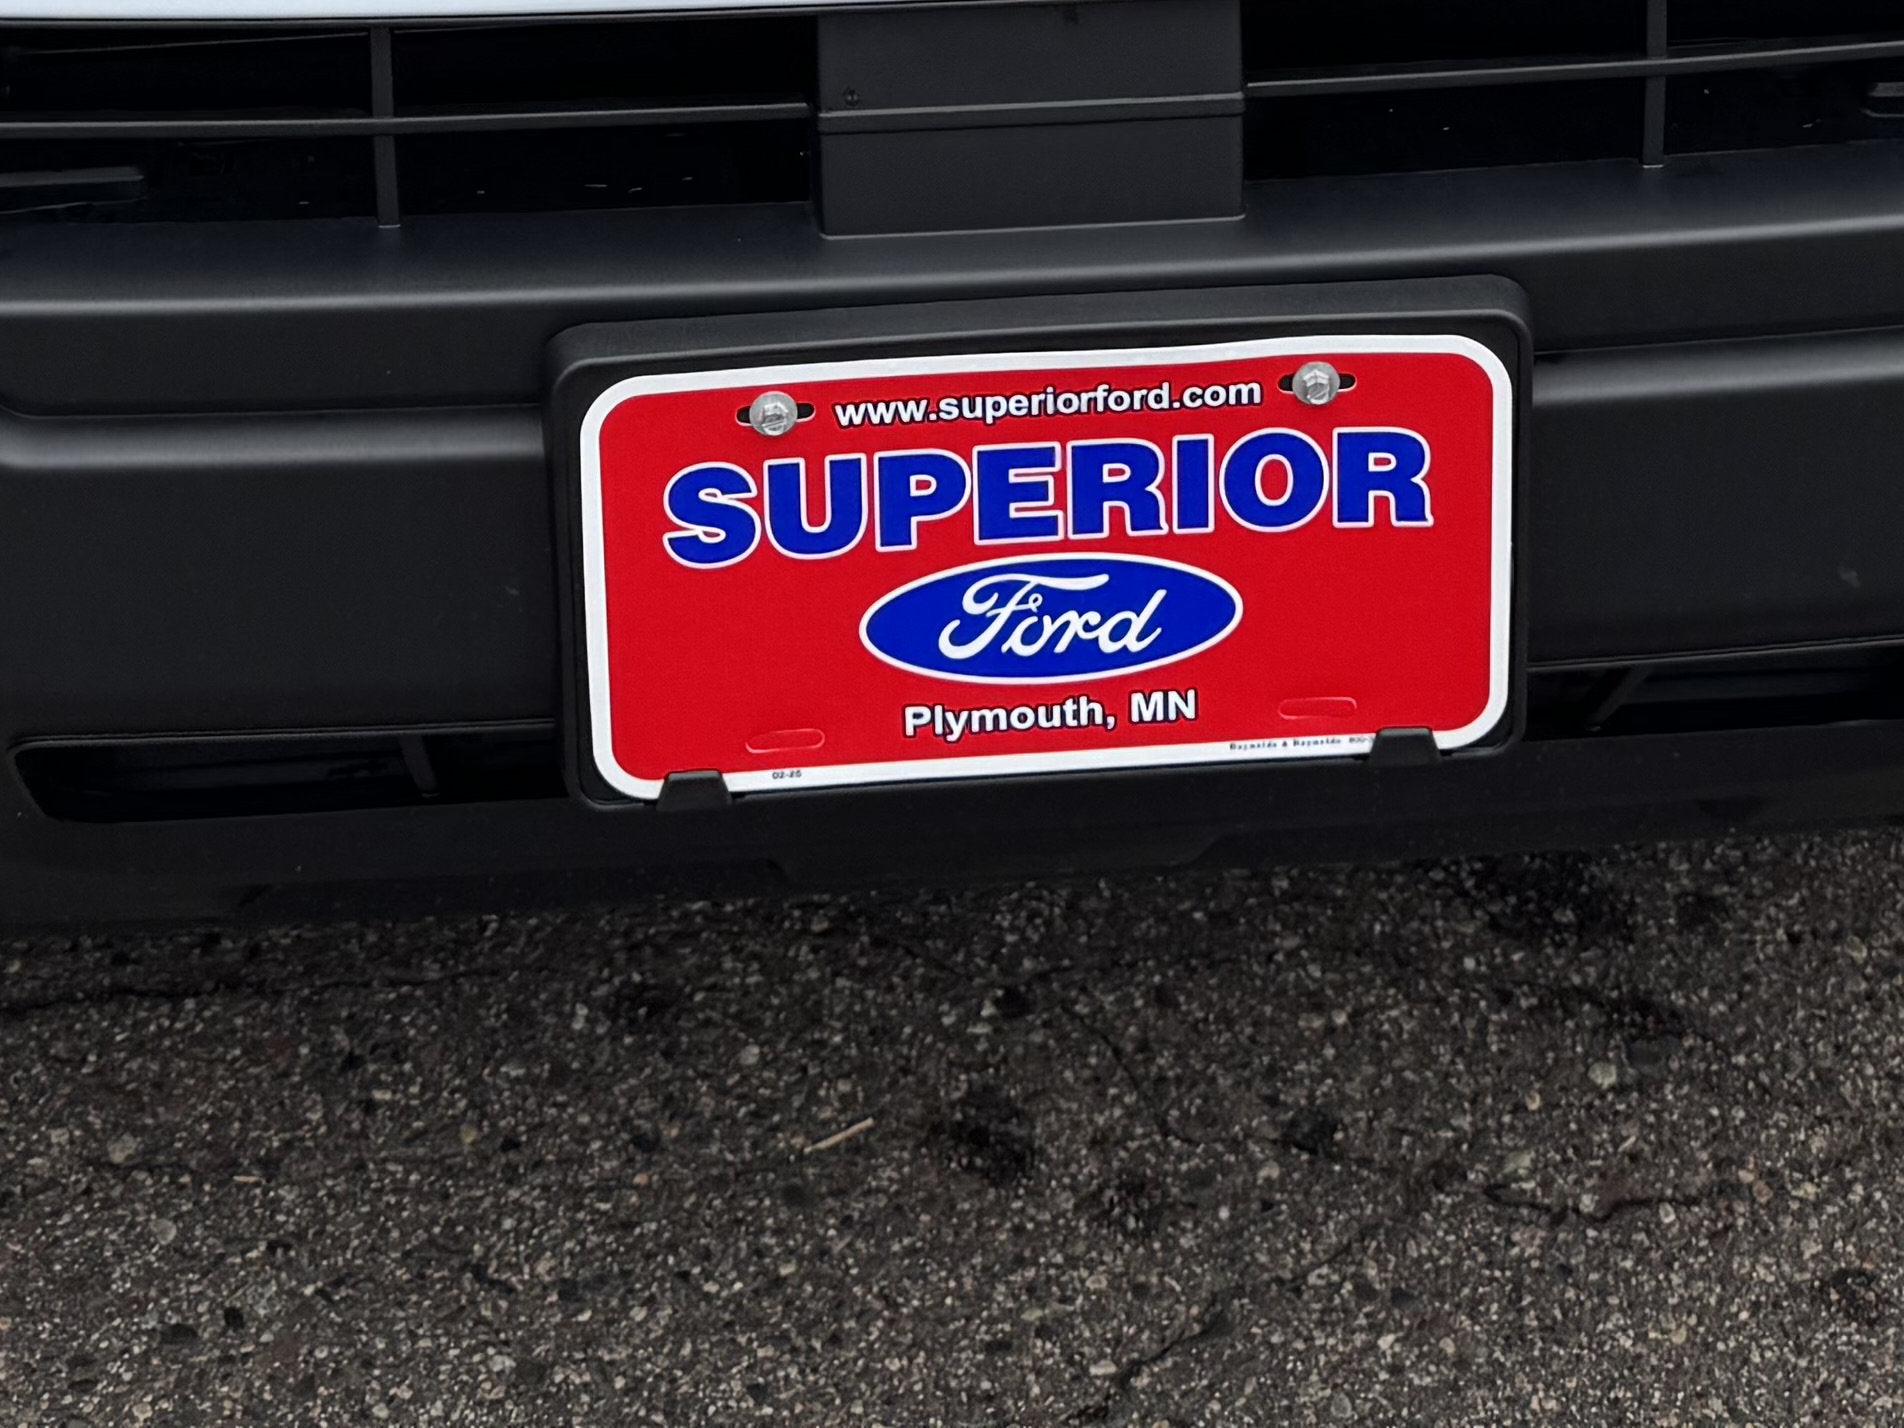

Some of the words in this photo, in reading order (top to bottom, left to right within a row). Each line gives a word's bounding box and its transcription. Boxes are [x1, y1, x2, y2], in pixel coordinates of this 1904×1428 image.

[833, 381, 1262, 428] www.superiorford.com
[663, 427, 1433, 569] SUPERIOR
[937, 572, 1165, 660] Ford
[903, 695, 1116, 743] Plymouth,
[1129, 688, 1197, 724] MN
